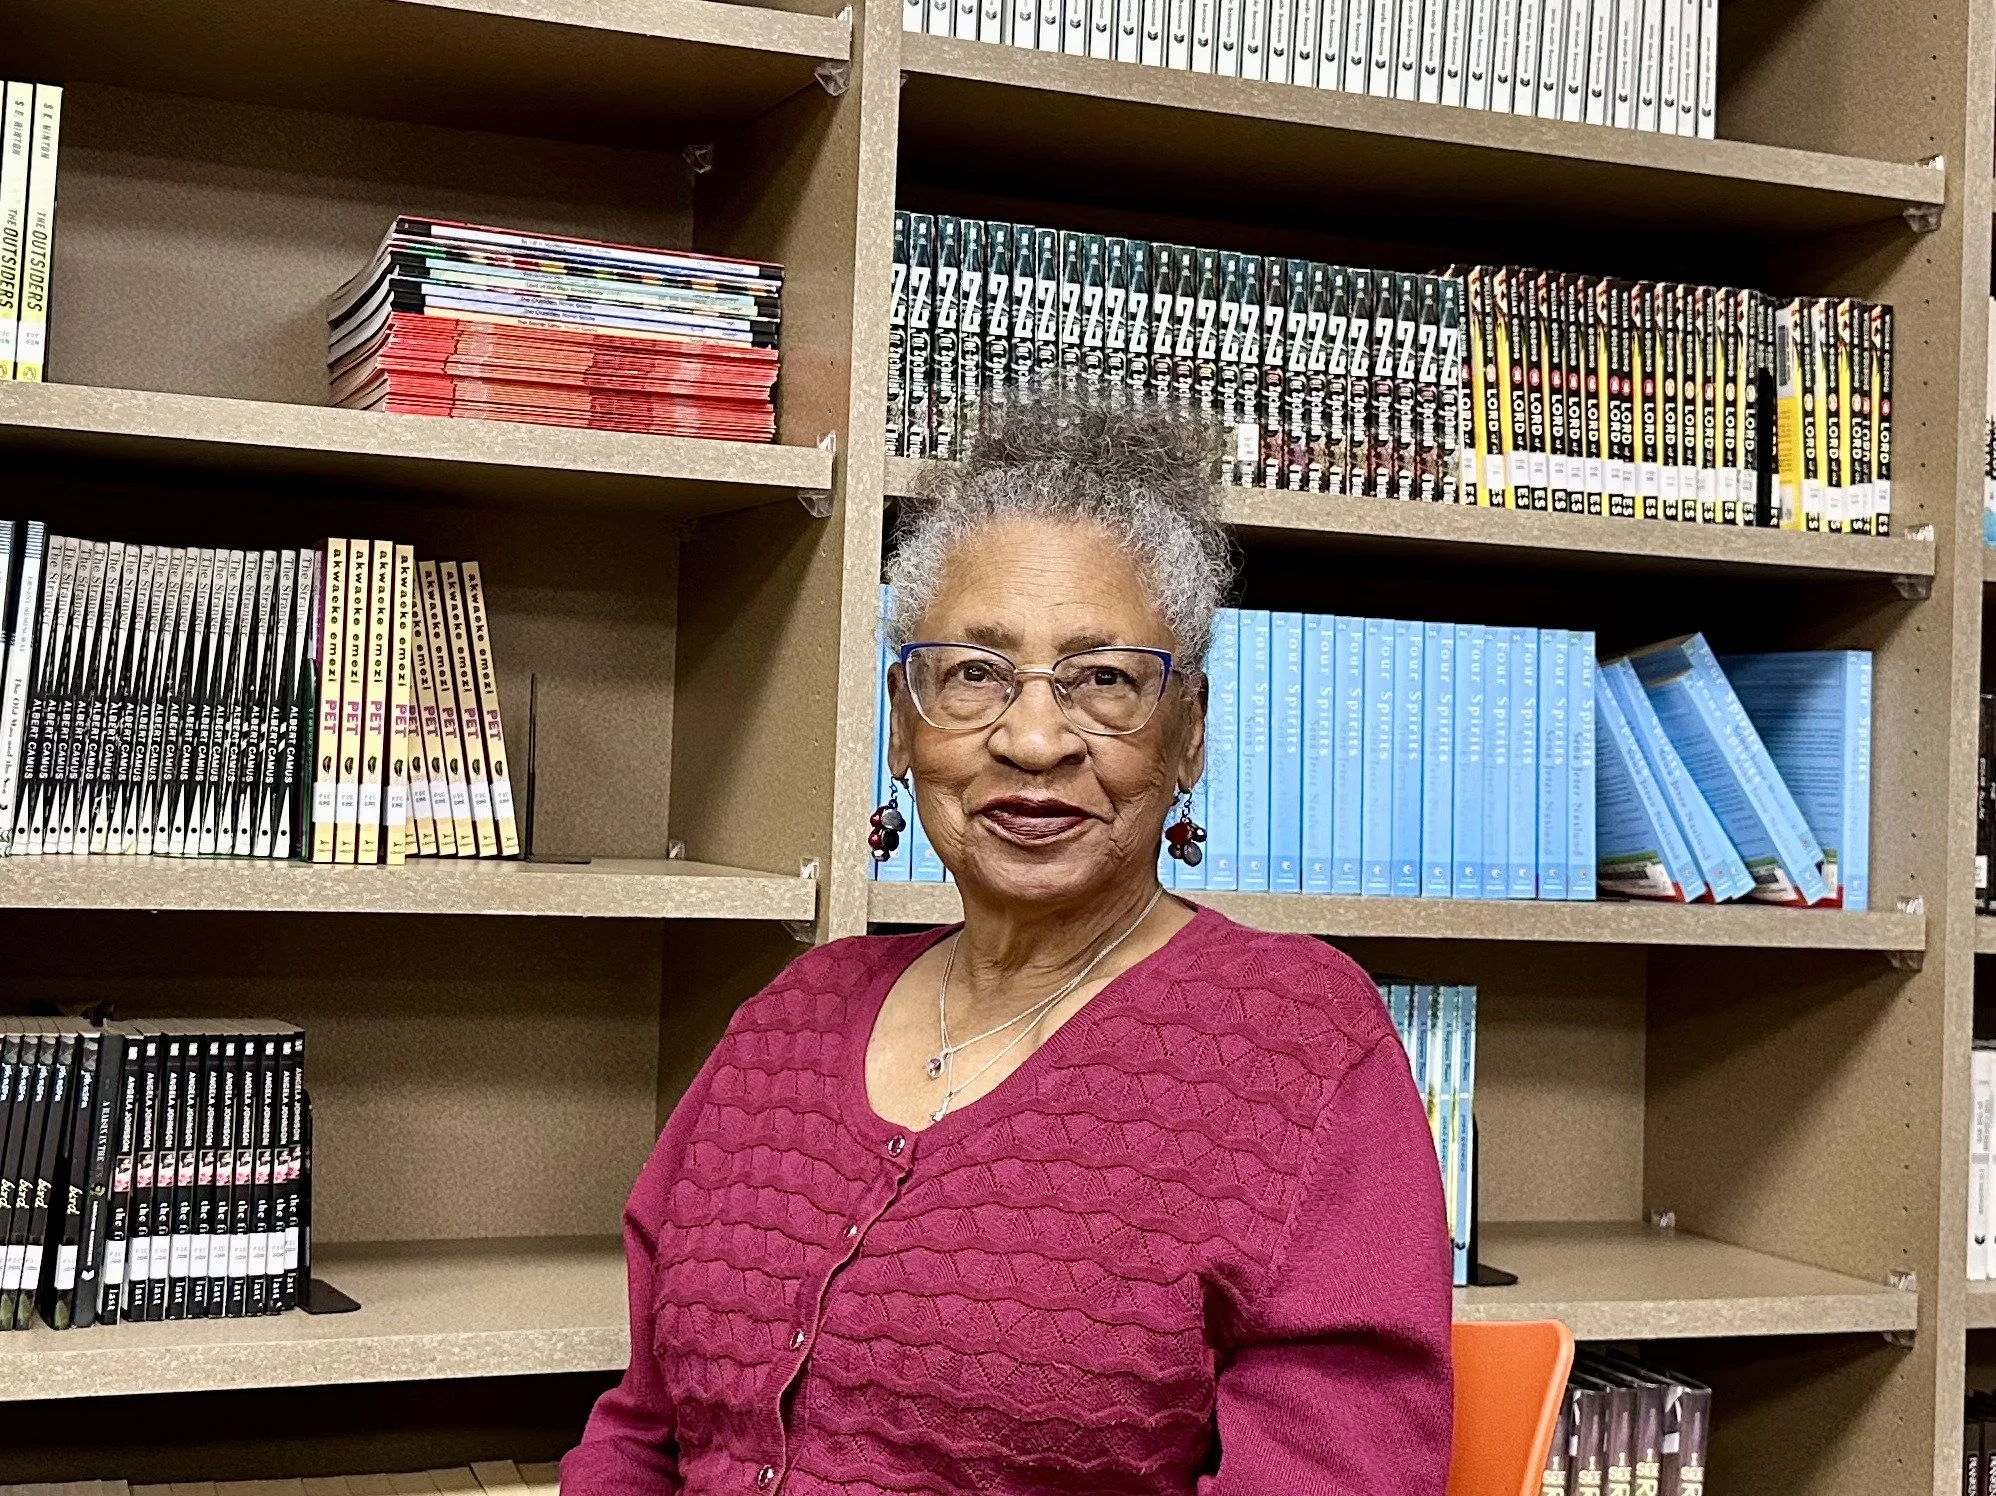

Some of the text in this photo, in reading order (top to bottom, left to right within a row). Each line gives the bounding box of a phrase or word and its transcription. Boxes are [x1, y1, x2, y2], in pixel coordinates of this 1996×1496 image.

[36, 212, 46, 229] THE
[0, 209, 18, 309] THE OUTSIDERS
[27, 230, 47, 312] OUTSIDERS
[1487, 389, 1498, 432] LORD
[1513, 390, 1526, 434] LORD
[1531, 392, 1543, 436] LORD
[1551, 394, 1563, 438] LORD
[1568, 397, 1580, 440] LORD
[1588, 399, 1599, 442] LORD
[1644, 402, 1655, 445] LORD
[1665, 403, 1676, 445] LORD
[1725, 406, 1736, 449] LORD
[1804, 417, 1815, 459] LORD
[1828, 417, 1839, 460] LORD
[1880, 422, 1890, 464] LORD
[50, 546, 62, 567] The
[93, 549, 105, 572] The
[109, 550, 121, 573] The
[126, 552, 138, 574] The
[170, 555, 183, 577] The
[186, 556, 197, 577] The
[216, 557, 227, 580] The
[264, 558, 274, 580] The
[328, 549, 343, 682] akwaeke emezi
[351, 551, 365, 683] akwaeke emezi
[374, 550, 389, 683] akwaeke emezi
[398, 555, 410, 686] akwaeke emezi
[425, 571, 451, 692] akwaeke emezi
[447, 572, 472, 693] akwaeke emezi
[469, 573, 494, 694] akwaeke emezi
[416, 644, 431, 691] emezi
[1252, 626, 1269, 753] Four Spirits
[1285, 628, 1301, 754] Four Spirits
[1316, 630, 1333, 756] Four Spirits
[1346, 632, 1362, 756] Four Spirits
[1406, 635, 1422, 760] Four Spirits
[1437, 638, 1453, 762] Four Spirits
[1494, 642, 1509, 765] Four Spirits
[1521, 642, 1537, 765] Four Spirits
[1552, 643, 1568, 765] Four Spirits
[324, 700, 337, 734] PET
[346, 701, 360, 735] PET
[369, 701, 382, 735] PET
[395, 704, 407, 738] PET
[424, 705, 439, 737] PET
[442, 707, 457, 739] PET
[464, 708, 479, 739] PET
[486, 709, 501, 741] PET
[24, 699, 42, 779] ALBERT CAMUS
[39, 699, 56, 779] ALBERT CAMUS
[55, 701, 72, 779] ALBERT CAMUS
[85, 701, 102, 780] ALBERT CAMUS
[180, 703, 195, 780] ALBERT CAMUS
[210, 705, 225, 781] ALBERT CAMUS
[265, 706, 280, 783] ALBERT CAMUS
[284, 705, 298, 783] ALBERT CAMUS
[107, 1289, 118, 1310] last
[135, 1284, 145, 1305] last
[175, 1282, 186, 1303] last
[213, 1281, 224, 1302] last
[233, 1280, 244, 1300] last
[287, 1273, 296, 1293] last
